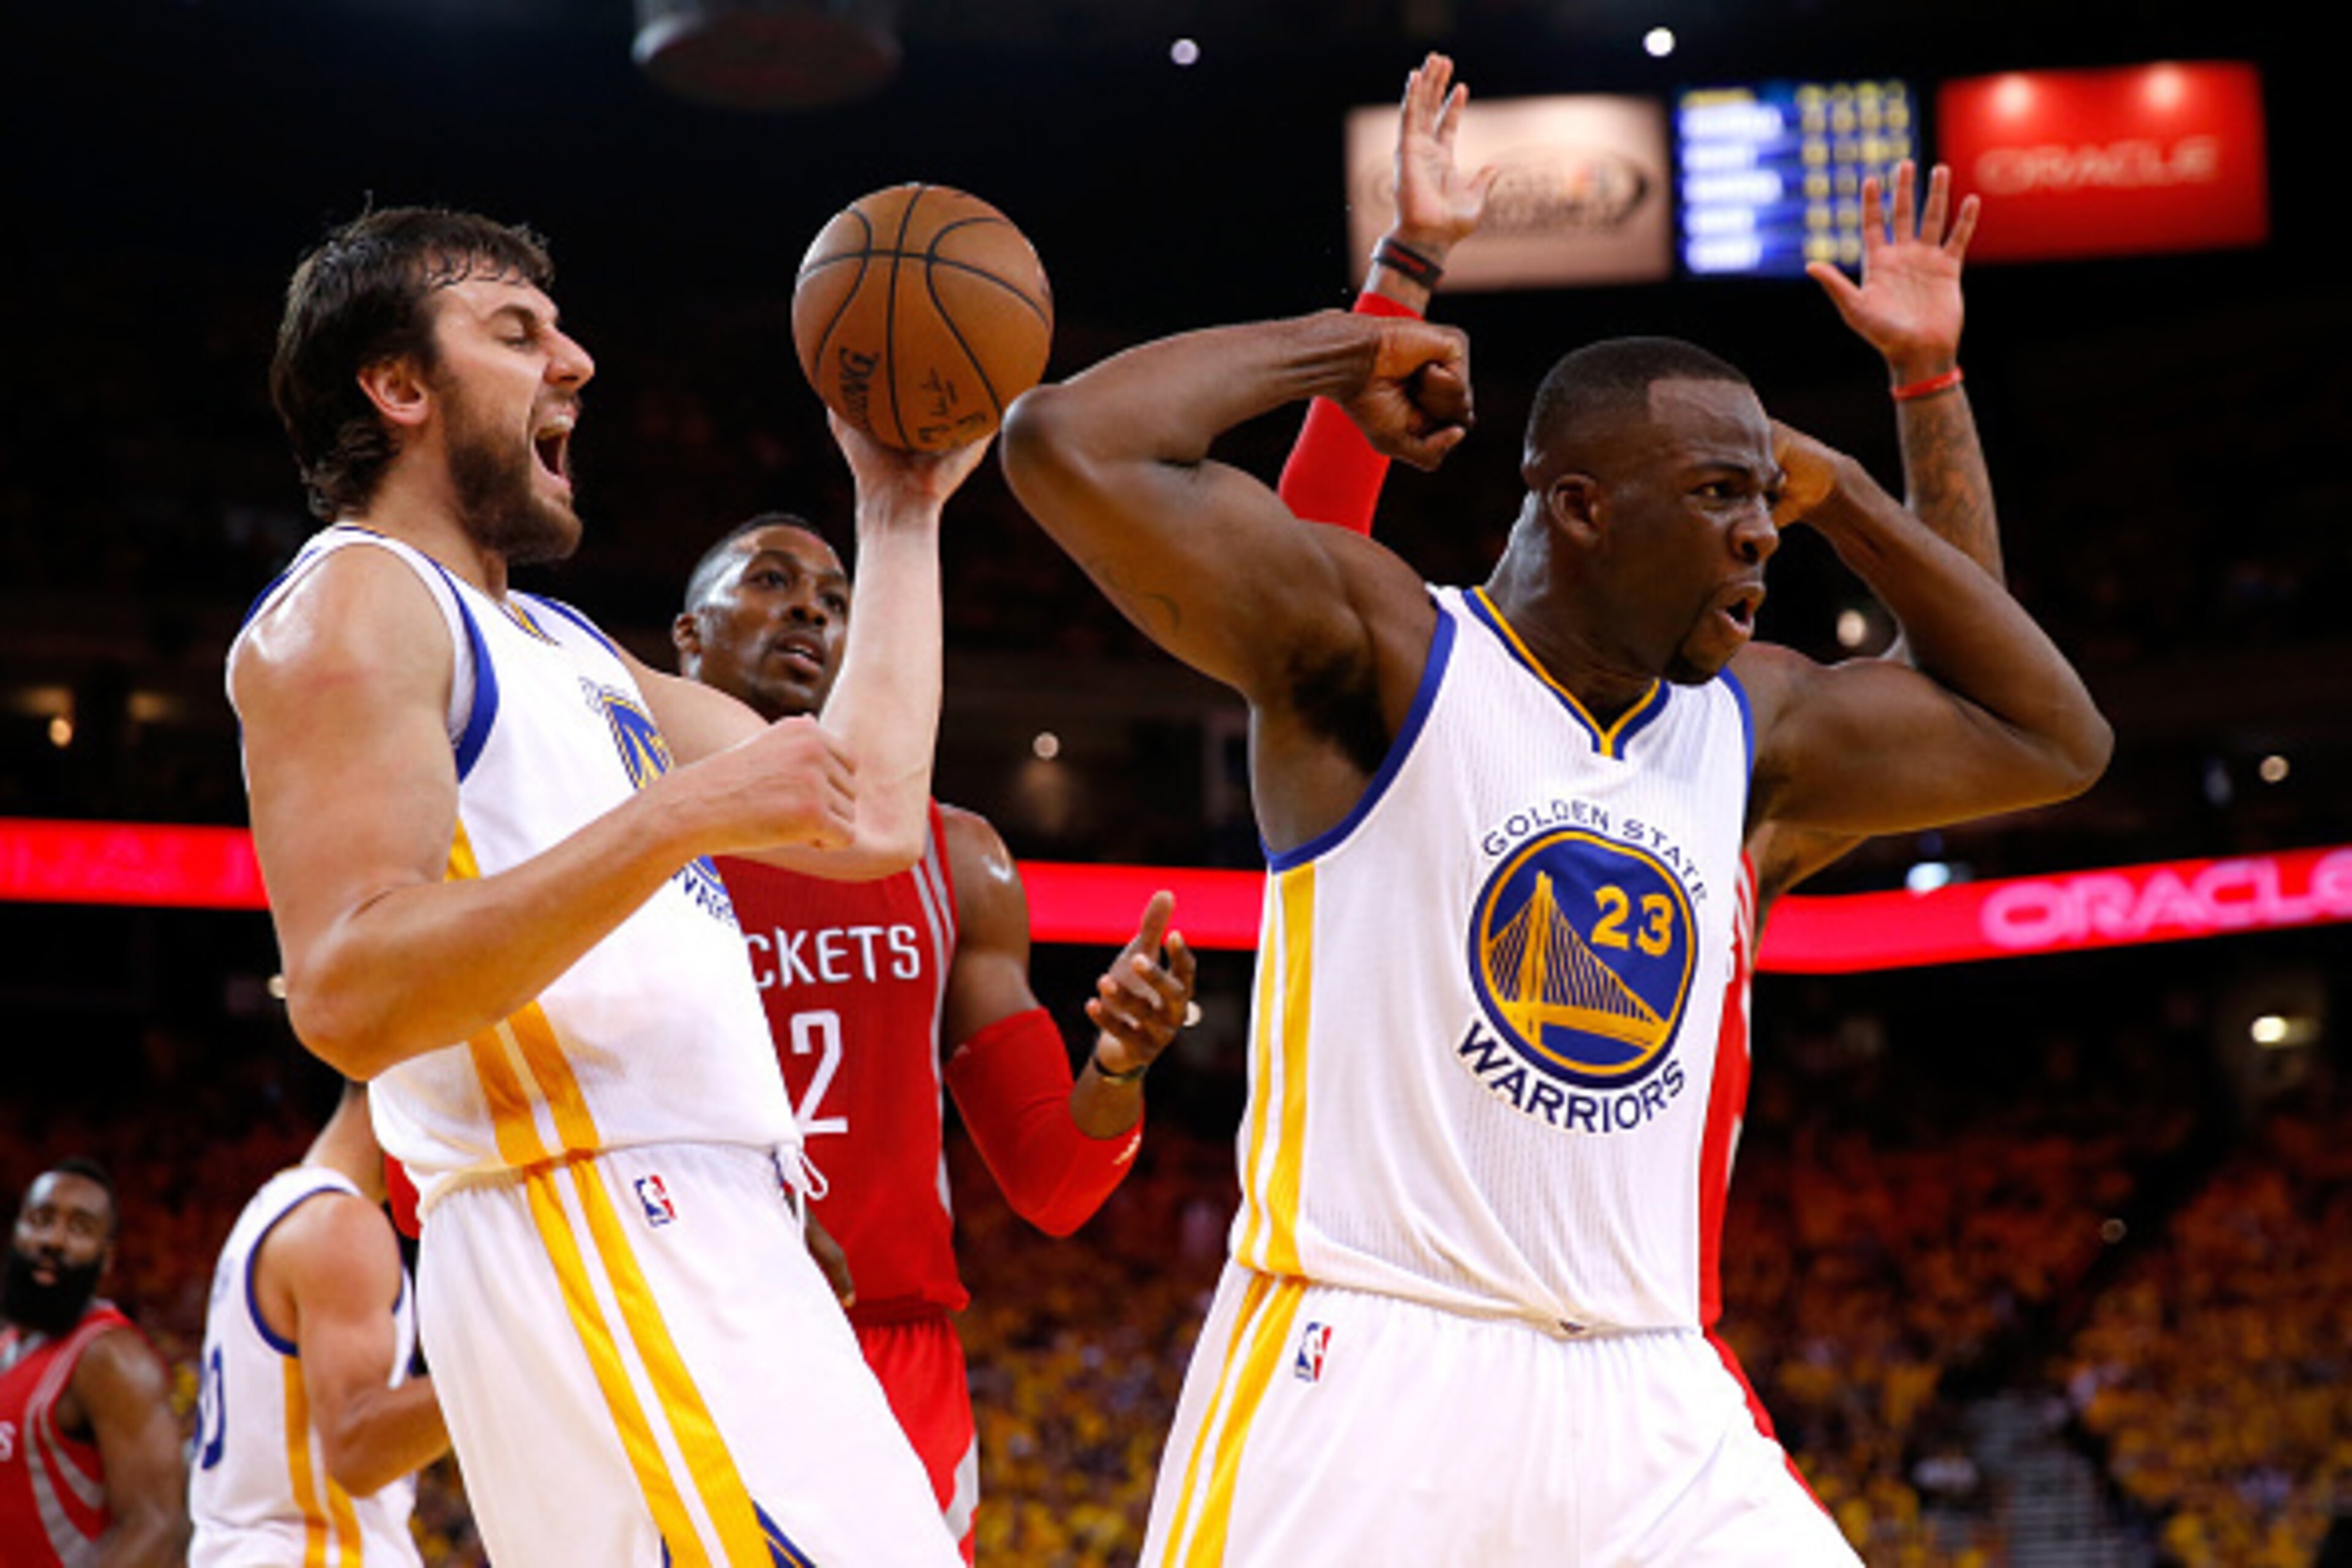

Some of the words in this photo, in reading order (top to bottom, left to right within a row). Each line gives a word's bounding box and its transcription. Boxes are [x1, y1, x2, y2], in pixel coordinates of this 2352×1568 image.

[1482, 799, 1609, 856] GOLDEN
[1622, 818, 1707, 904] STATE
[1592, 885, 1675, 957] 23
[1458, 1019, 1685, 1133] WARRIORS
